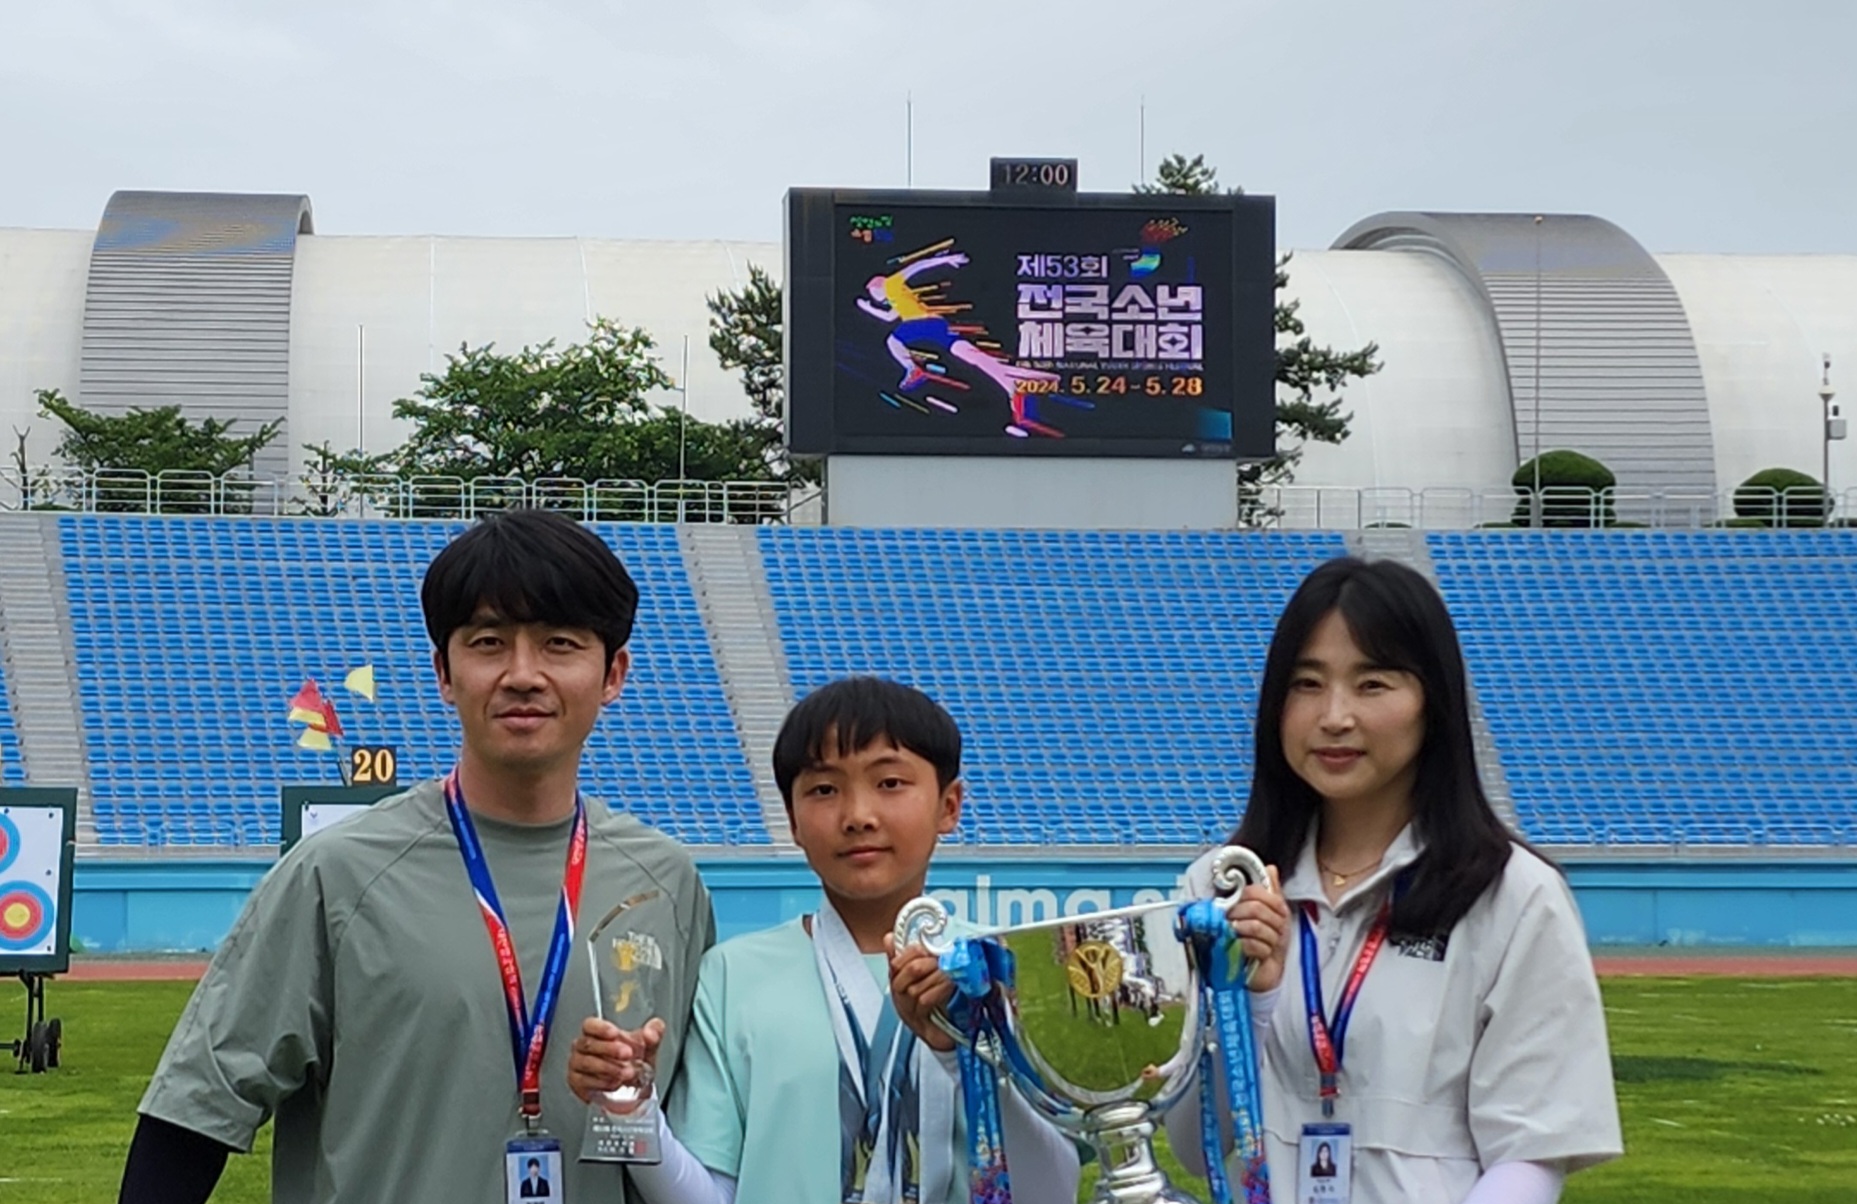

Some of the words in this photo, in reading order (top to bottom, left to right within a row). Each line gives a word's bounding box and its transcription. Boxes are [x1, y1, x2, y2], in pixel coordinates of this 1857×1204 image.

[1004, 164, 1068, 186] 12:00
[1017, 254, 1108, 278] 제53회
[1017, 284, 1202, 320] 전국소년
[1017, 321, 1203, 359] 체육대회
[1096, 376, 1126, 394] 24
[1172, 377, 1203, 396] 28
[353, 749, 394, 782] 20
